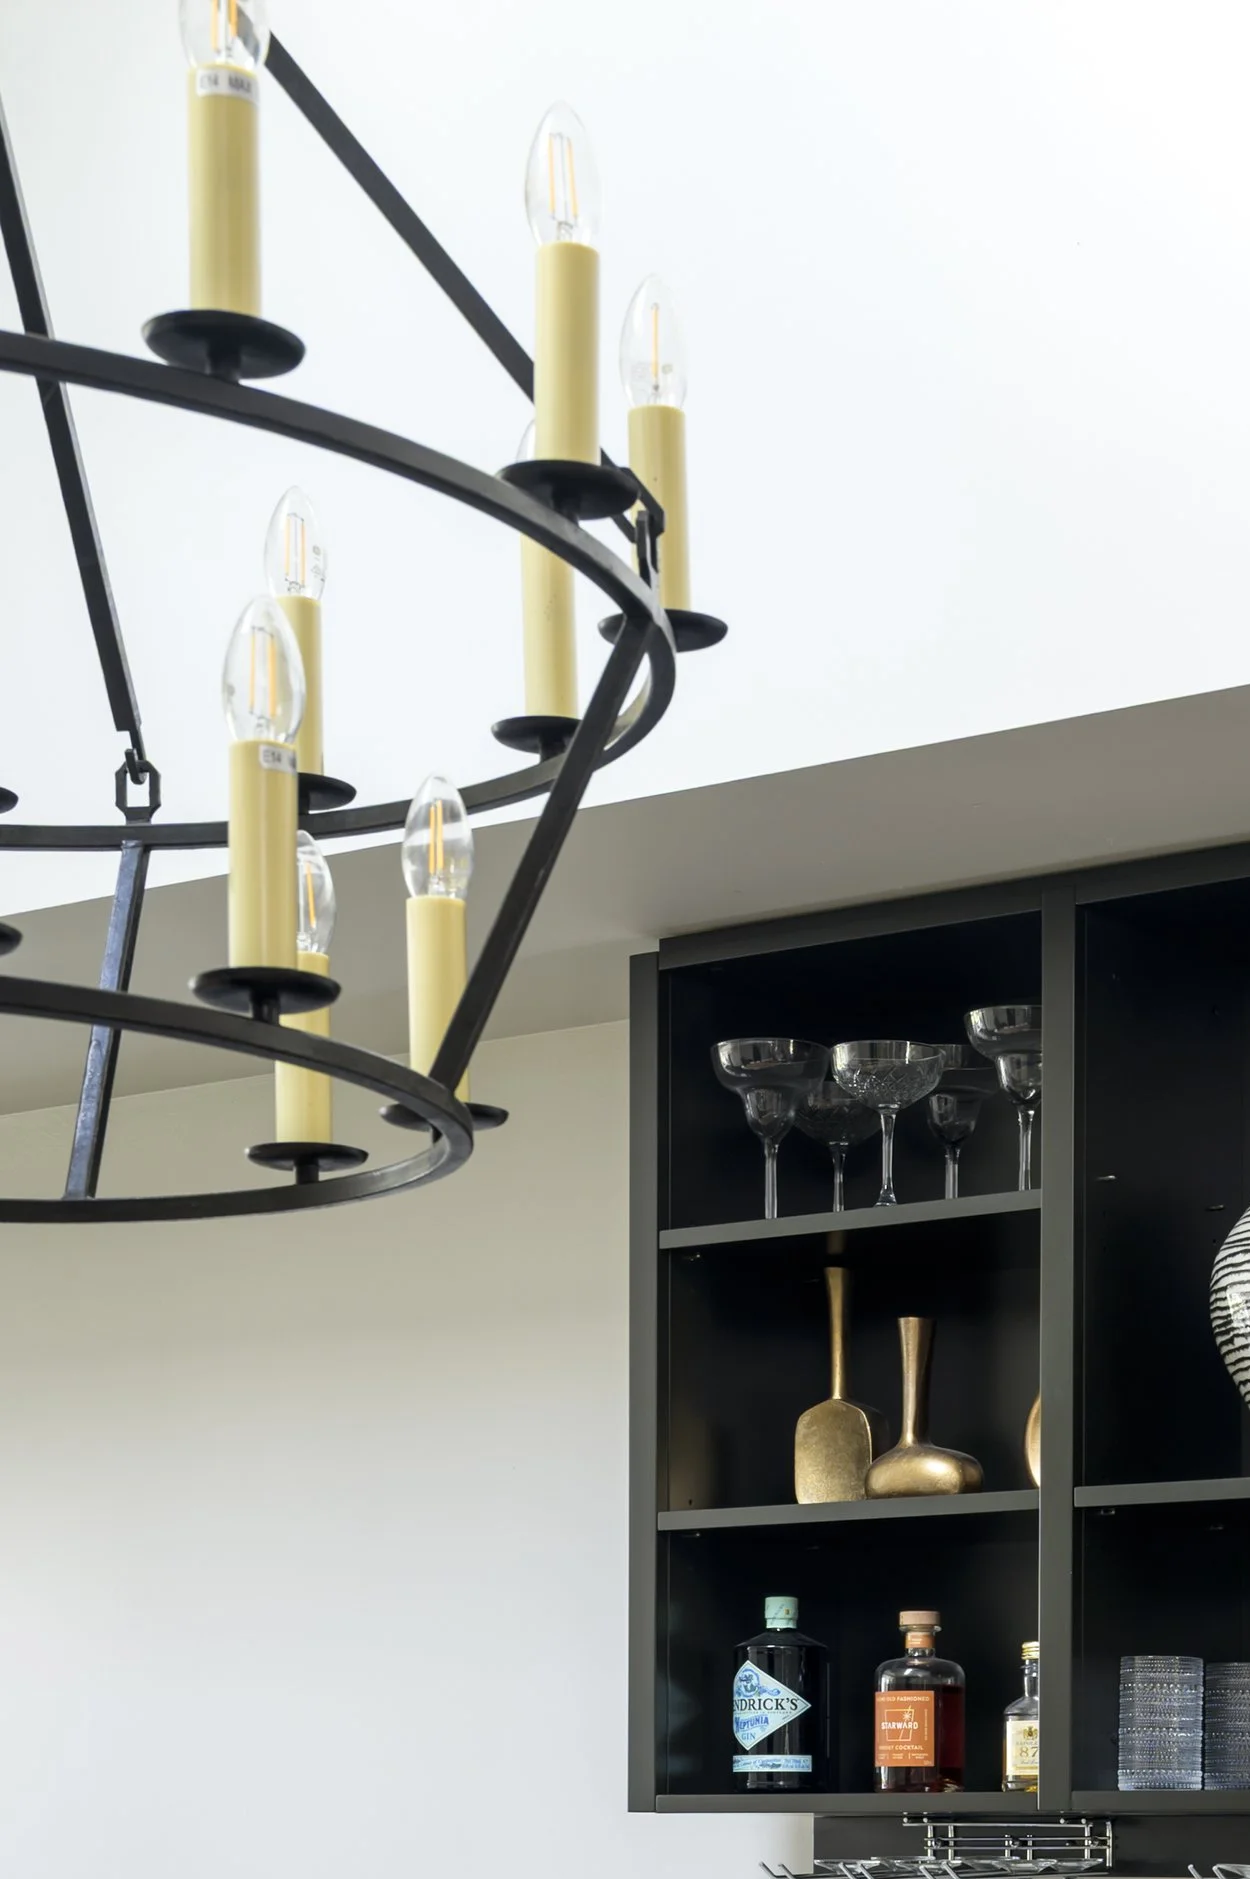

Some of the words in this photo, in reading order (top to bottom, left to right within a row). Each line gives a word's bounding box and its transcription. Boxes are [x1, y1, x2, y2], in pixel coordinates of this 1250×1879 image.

[734, 1697, 798, 1711] NDRICK'S
[734, 1714, 770, 1732] NEPTUNIA
[881, 1721, 919, 1730] STARWARD
[741, 1732, 756, 1741] GIN
